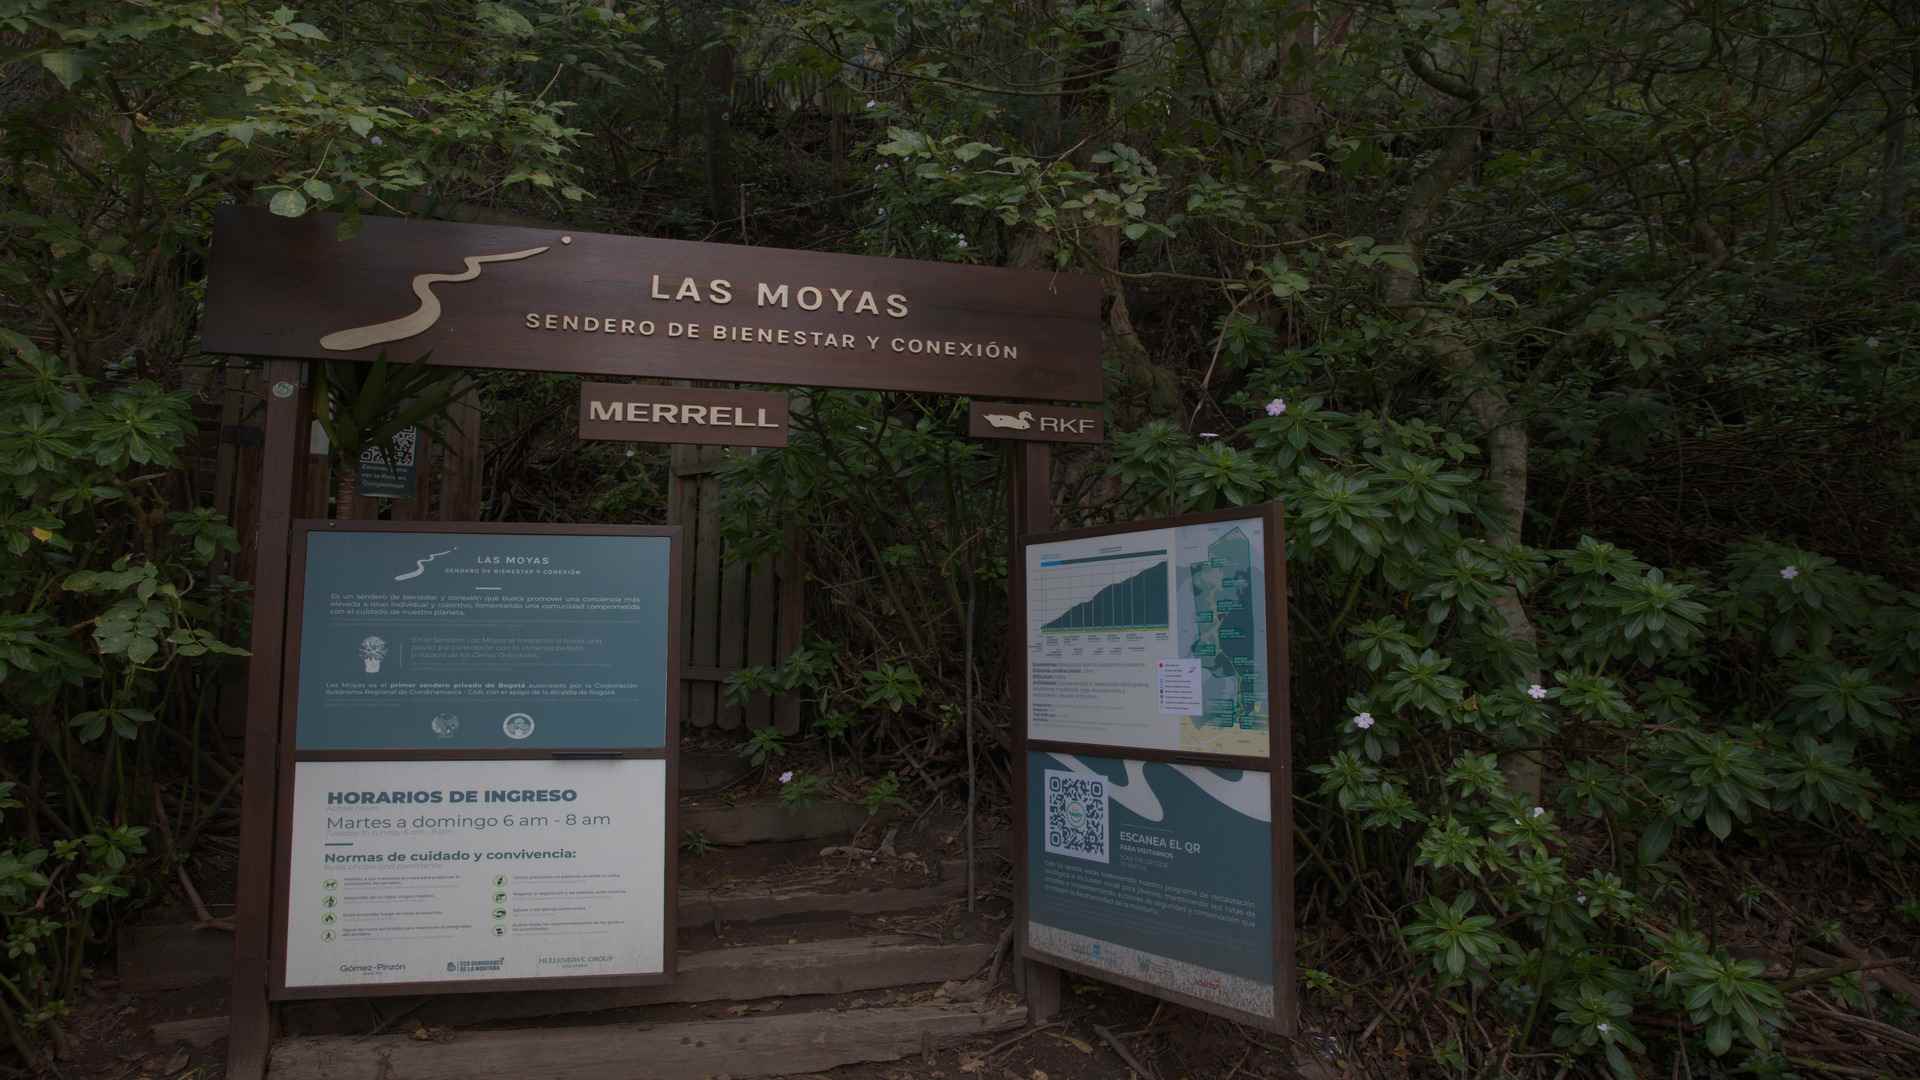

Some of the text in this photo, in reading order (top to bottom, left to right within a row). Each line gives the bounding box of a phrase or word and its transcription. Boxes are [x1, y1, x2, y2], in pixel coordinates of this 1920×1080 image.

[652, 275, 909, 318] LAS MOYAS
[526, 313, 1018, 361] SENDERO DE BIENESTAR Y CONEXIÓN
[589, 401, 780, 428] MERRELL
[1040, 417, 1096, 433] RKF
[478, 556, 550, 565] LAS MOYAS
[328, 789, 578, 804] HORARIOS DE INGRESO
[327, 816, 391, 829] Martes
[396, 818, 407, 828] a
[412, 814, 498, 831] domingo
[503, 815, 515, 827] 6
[519, 817, 548, 827] am
[565, 814, 577, 826] 8
[582, 816, 611, 826] am
[1120, 831, 1201, 854] ESCANEA EL QR
[1120, 844, 1136, 853] PARA
[325, 848, 577, 864] Normas de cuidado y convivencia:
